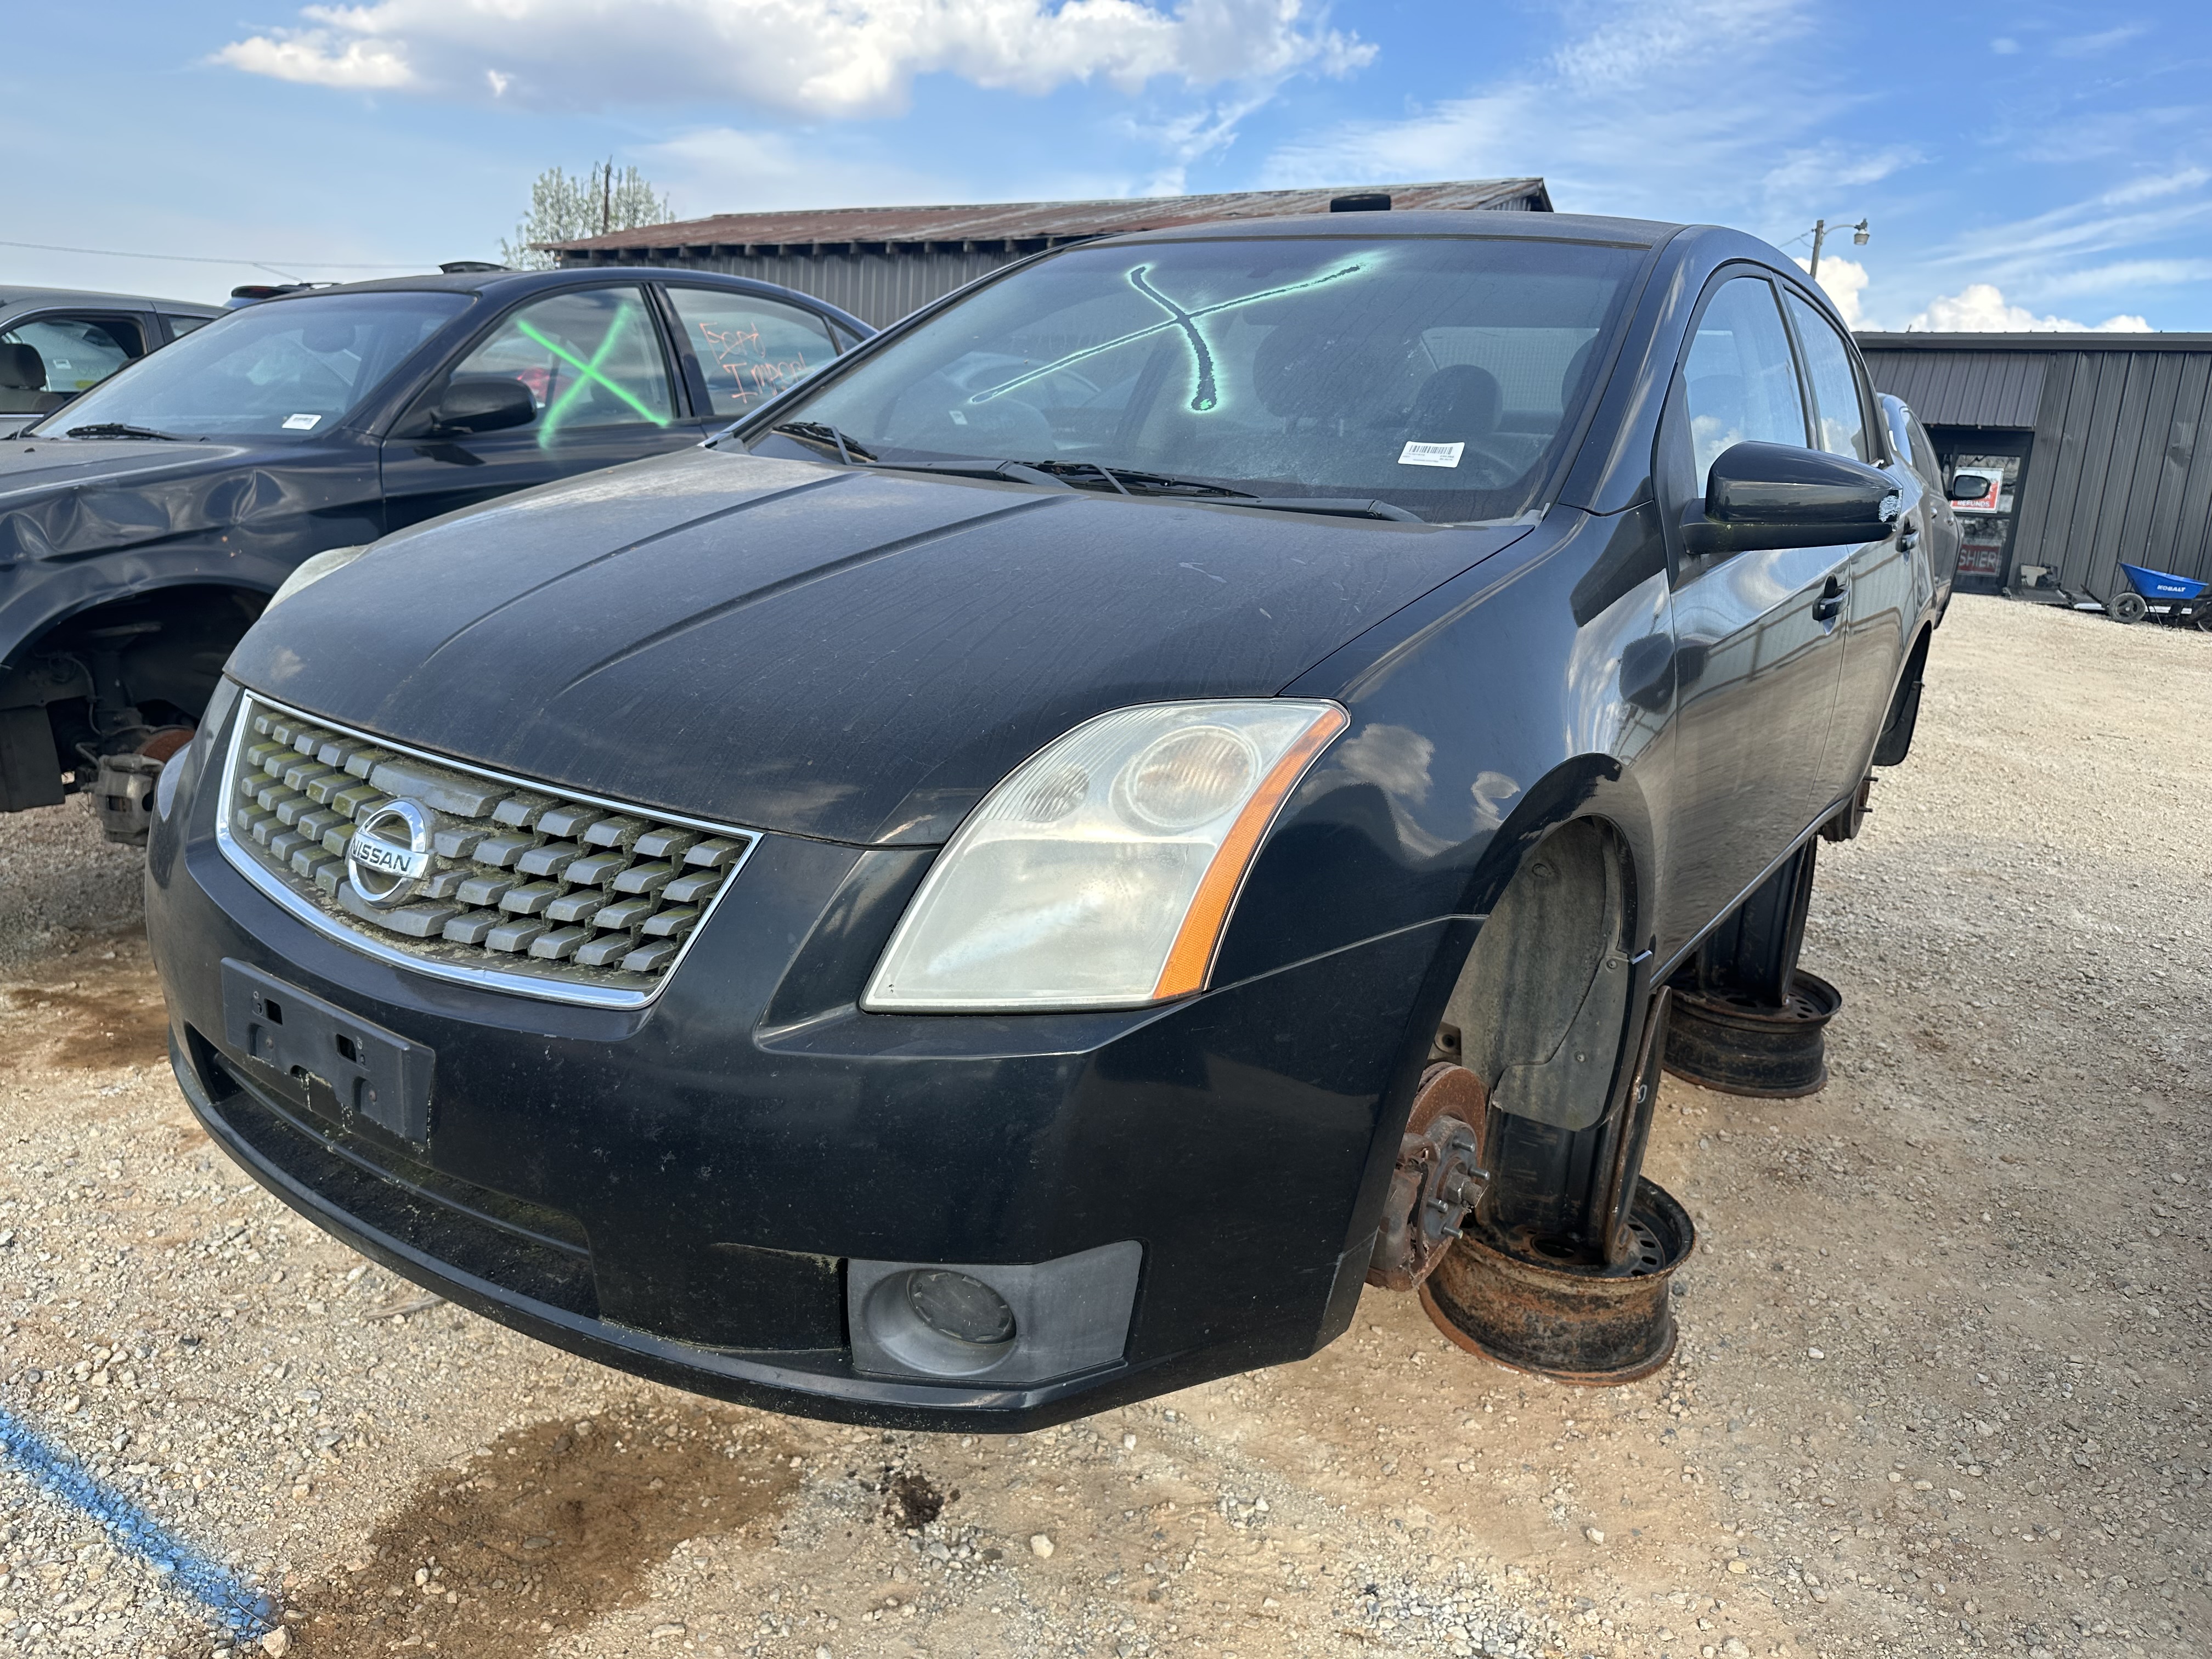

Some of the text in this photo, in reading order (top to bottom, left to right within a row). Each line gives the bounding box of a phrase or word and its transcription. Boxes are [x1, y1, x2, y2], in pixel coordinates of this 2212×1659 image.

[1959, 549, 1997, 568] SHIER
[2157, 584, 2186, 592] KOBALT
[351, 839, 411, 872] NISSAN
